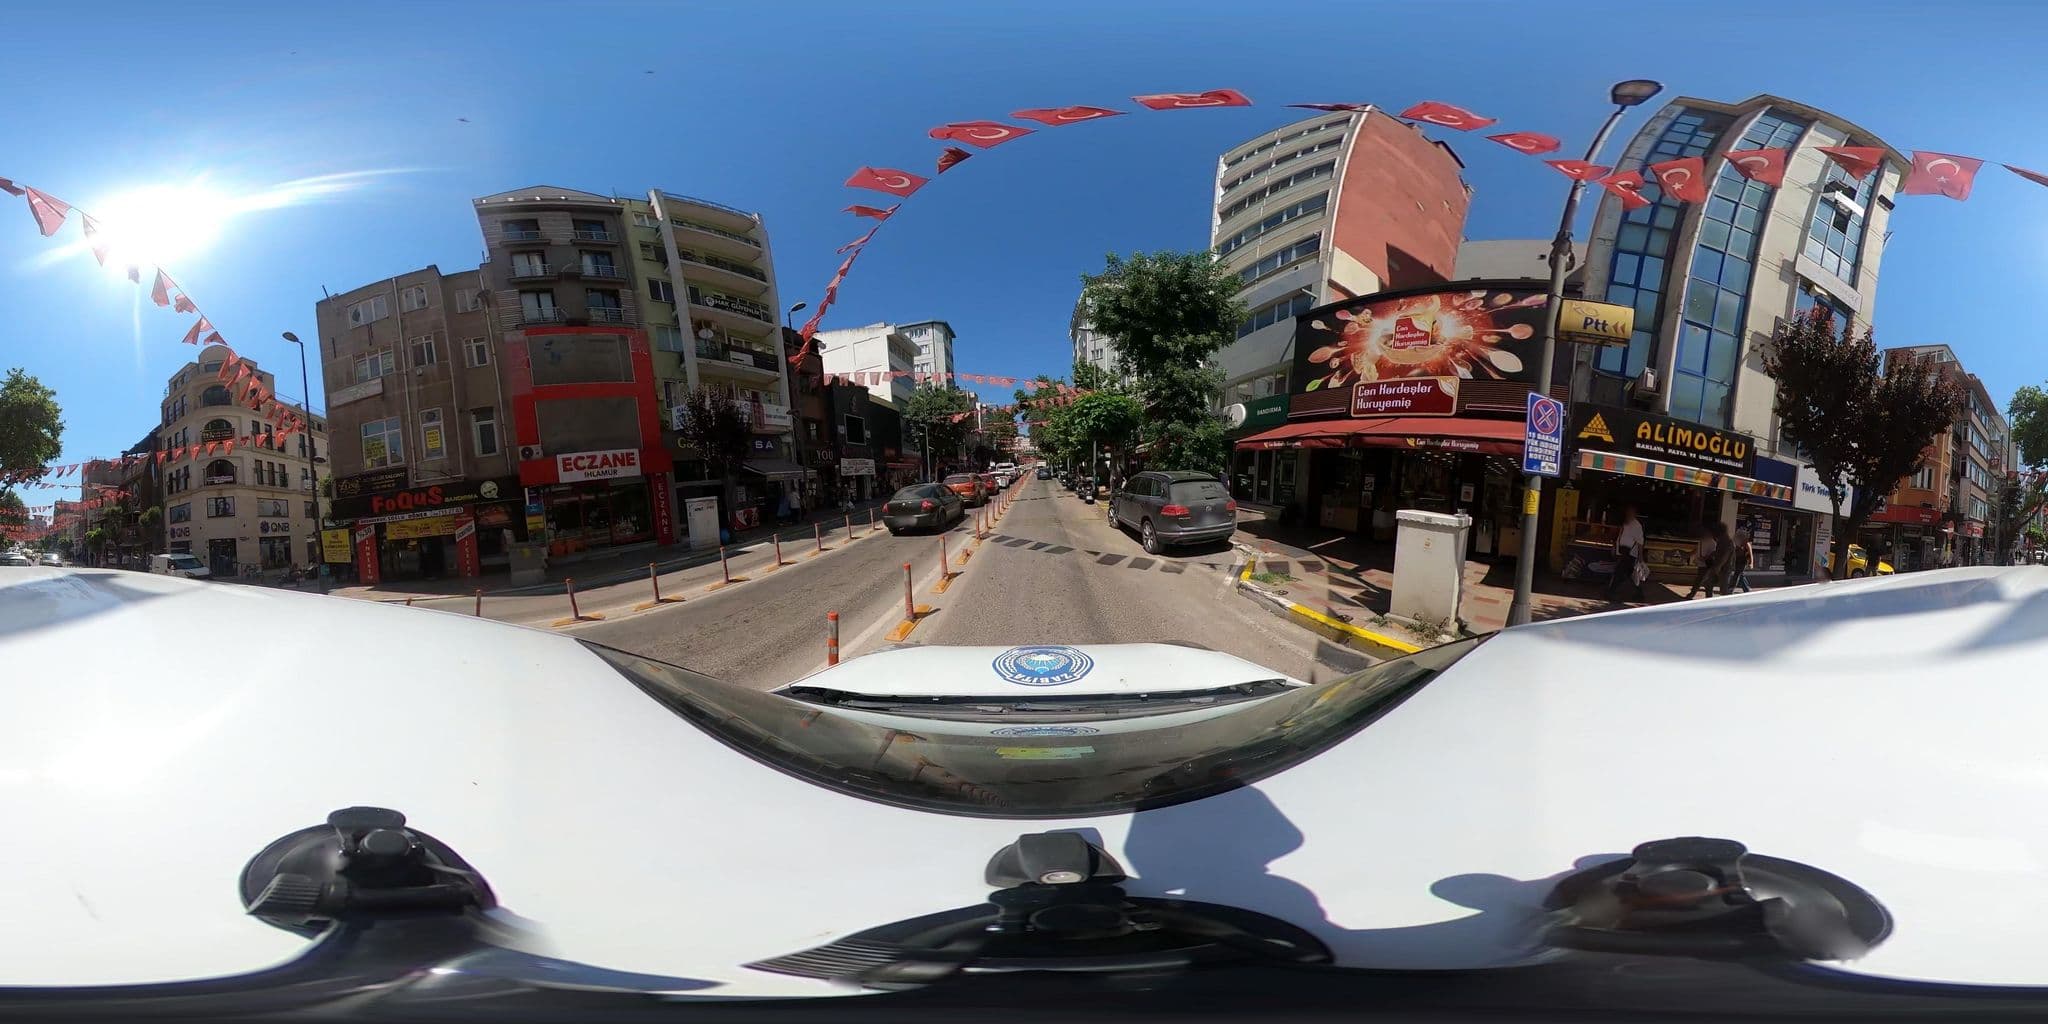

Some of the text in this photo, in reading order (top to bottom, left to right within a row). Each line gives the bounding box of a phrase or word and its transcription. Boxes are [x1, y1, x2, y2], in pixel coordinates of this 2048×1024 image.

[1583, 316, 1609, 333] Ptt
[1357, 382, 1433, 397] Can Kardeşler
[1356, 398, 1412, 411] Kuruyemiş
[1637, 421, 1747, 459] ALİMOĞLU
[561, 452, 636, 473] ECZANE
[1801, 481, 1816, 493] Türk
[658, 483, 670, 535] ECZANE
[176, 527, 191, 537] QNB
[270, 522, 290, 532] QNB
[1013, 672, 1072, 684] ZABITA
